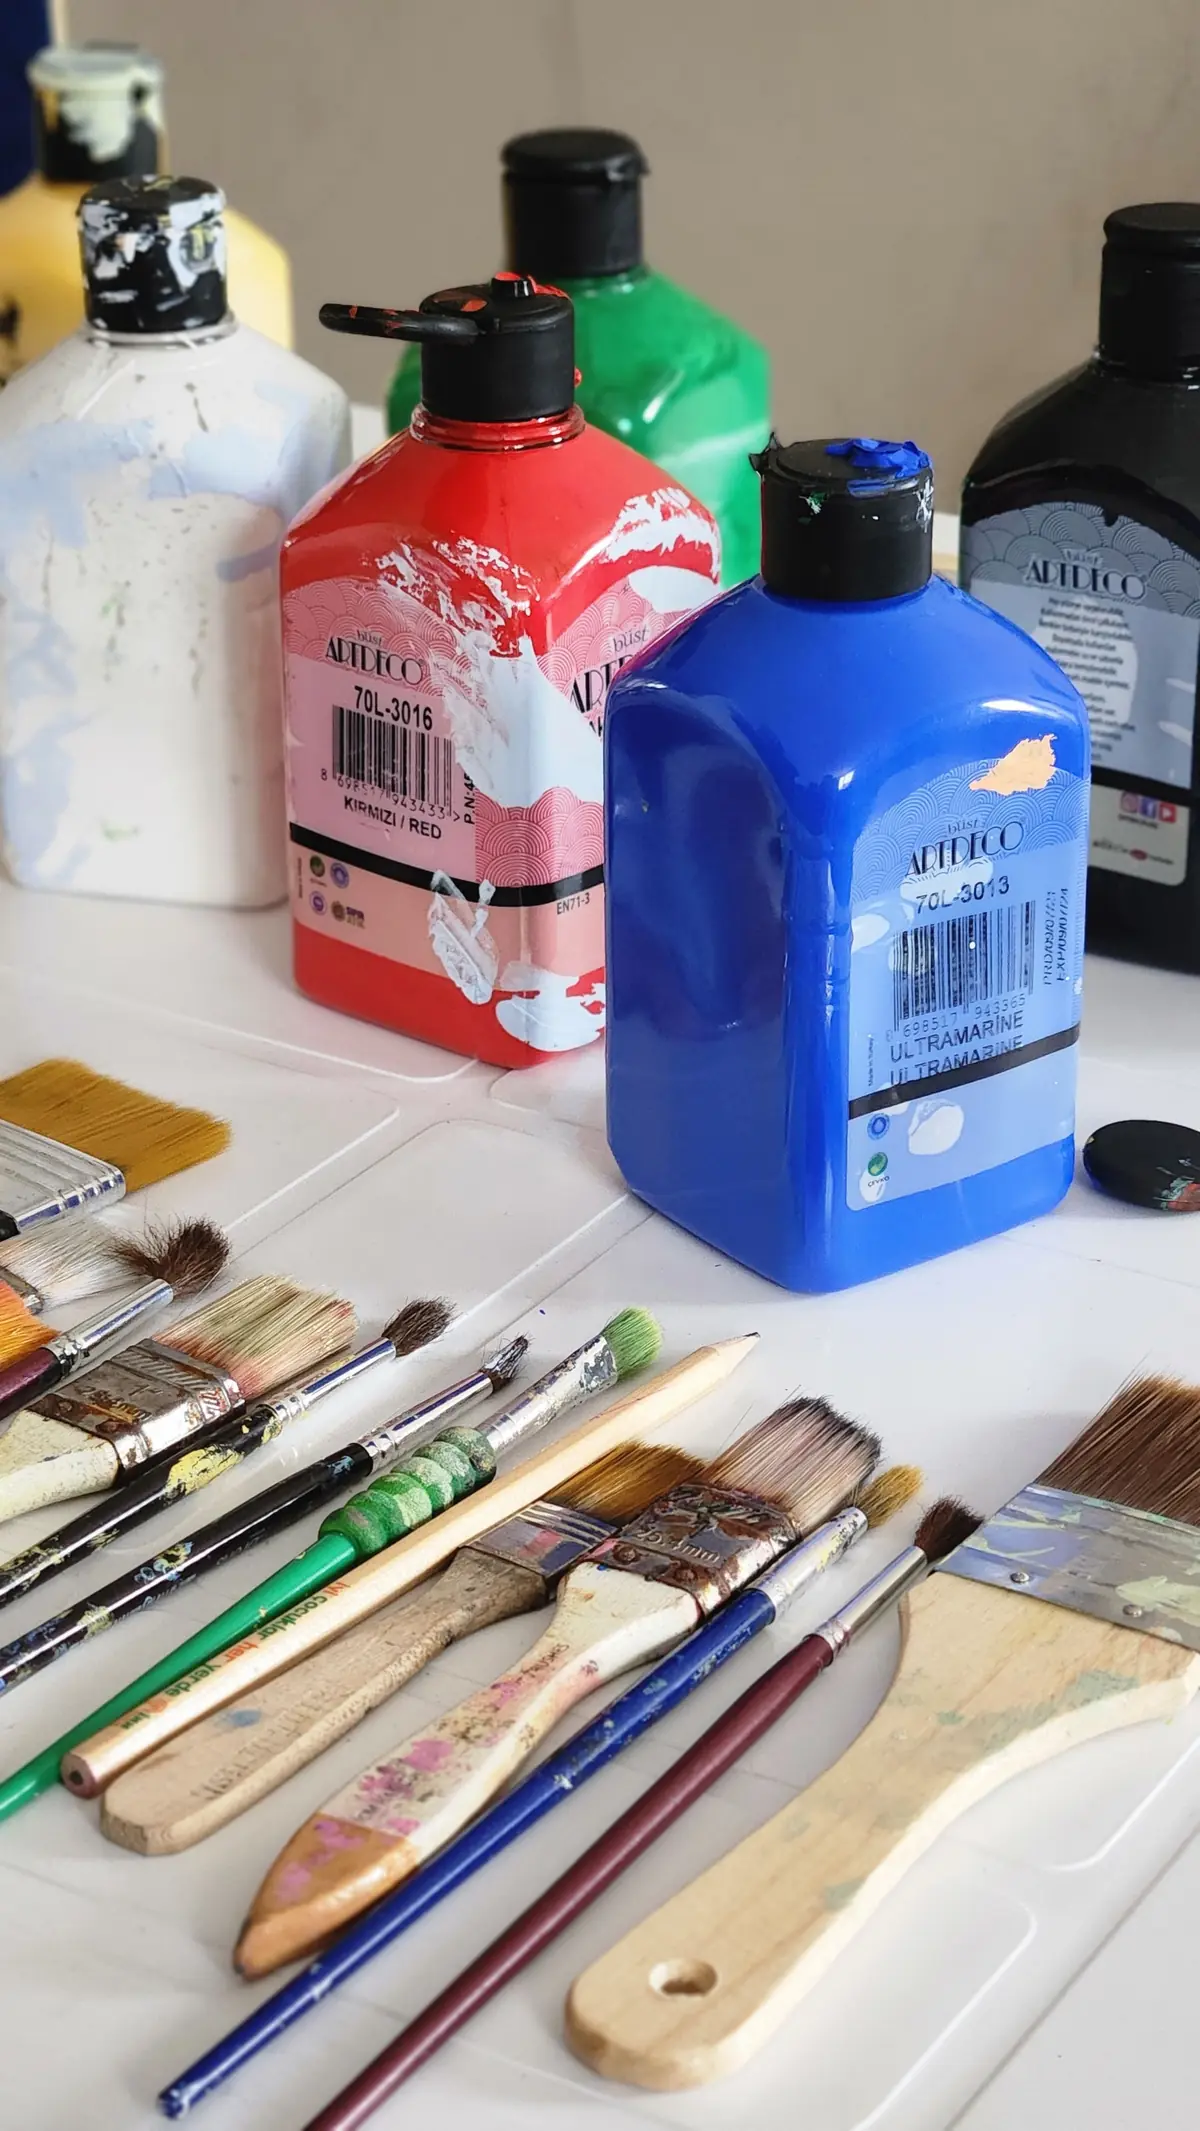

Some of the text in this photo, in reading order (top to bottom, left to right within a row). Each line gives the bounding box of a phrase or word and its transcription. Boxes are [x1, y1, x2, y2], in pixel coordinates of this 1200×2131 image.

[1025, 559, 1146, 600] ARTDECO
[326, 636, 423, 686] ARTDECO
[354, 685, 433, 731] 70L-3016
[344, 795, 397, 827] KIRMIZI
[408, 817, 442, 840] RED
[904, 820, 1025, 877] ARTDECO
[556, 892, 590, 915] EN71-3
[916, 875, 1010, 915] 70L-3013
[903, 1012, 958, 1039] 698517
[974, 993, 1026, 1020] 943365
[223, 1641, 258, 1663] her
[163, 1663, 222, 1697] yerde
